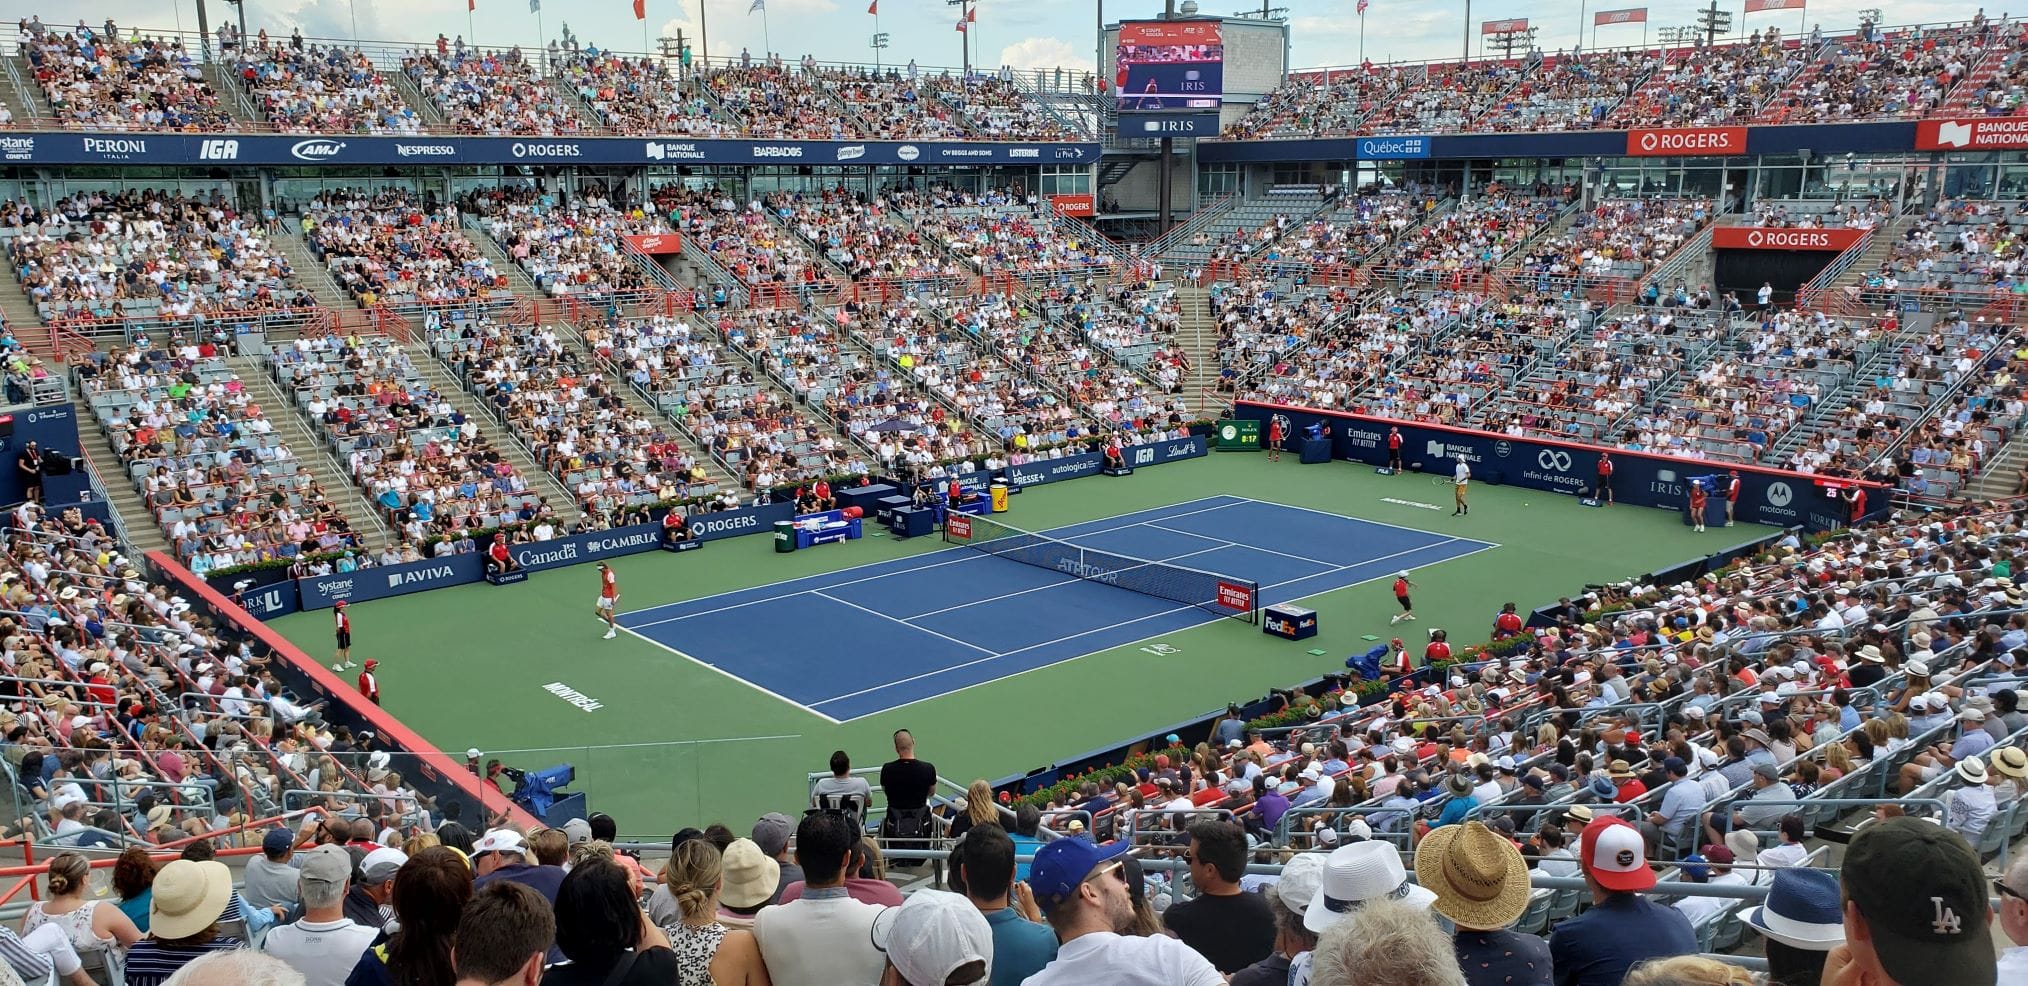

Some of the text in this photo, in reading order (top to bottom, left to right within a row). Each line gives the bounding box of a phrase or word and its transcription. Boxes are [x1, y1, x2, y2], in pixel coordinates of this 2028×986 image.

[1181, 82, 1205, 91] IRIS
[1162, 121, 1194, 131] IRIS
[1977, 121, 2028, 133] BANQUE
[83, 138, 146, 153] PERONI
[1660, 132, 1729, 149] ROGERS
[200, 140, 239, 159] IGA
[301, 144, 340, 155] AMJ
[528, 145, 580, 156] ROGERS
[667, 144, 695, 152] BANQUE
[753, 147, 802, 158] BARBADOS
[1009, 148, 1039, 158] LISTERINE
[1364, 139, 1405, 156] Québec
[667, 151, 705, 159] NATIONALE
[1065, 203, 1090, 211] ROGERS
[1766, 233, 1829, 246] ROGERS
[1348, 428, 1382, 441] Emirates
[1352, 438, 1376, 449] FLY BETTER
[1446, 443, 1473, 454] BANQUE
[1135, 448, 1154, 464] IGA
[1167, 445, 1189, 457] Lindt
[1012, 468, 1022, 477] LA
[1052, 461, 1087, 474] autologica
[1523, 470, 1584, 487] Infini de ROGERS
[1649, 481, 1682, 496] IRIS
[1826, 487, 1837, 498] 25
[1759, 505, 1797, 517] motorola
[707, 515, 757, 532] ROGERS
[1809, 512, 1831, 528] YORK
[601, 533, 658, 551] CAMBRIA
[519, 543, 578, 567] Canada
[404, 565, 454, 584] AVIVA
[1219, 585, 1249, 601] Emirates
[1223, 596, 1231, 604] FLY
[1265, 616, 1296, 636] FedEx
[1299, 618, 1316, 629] FedEx
[541, 682, 604, 713] MONTRÉAL
[1930, 896, 1962, 934] LA
